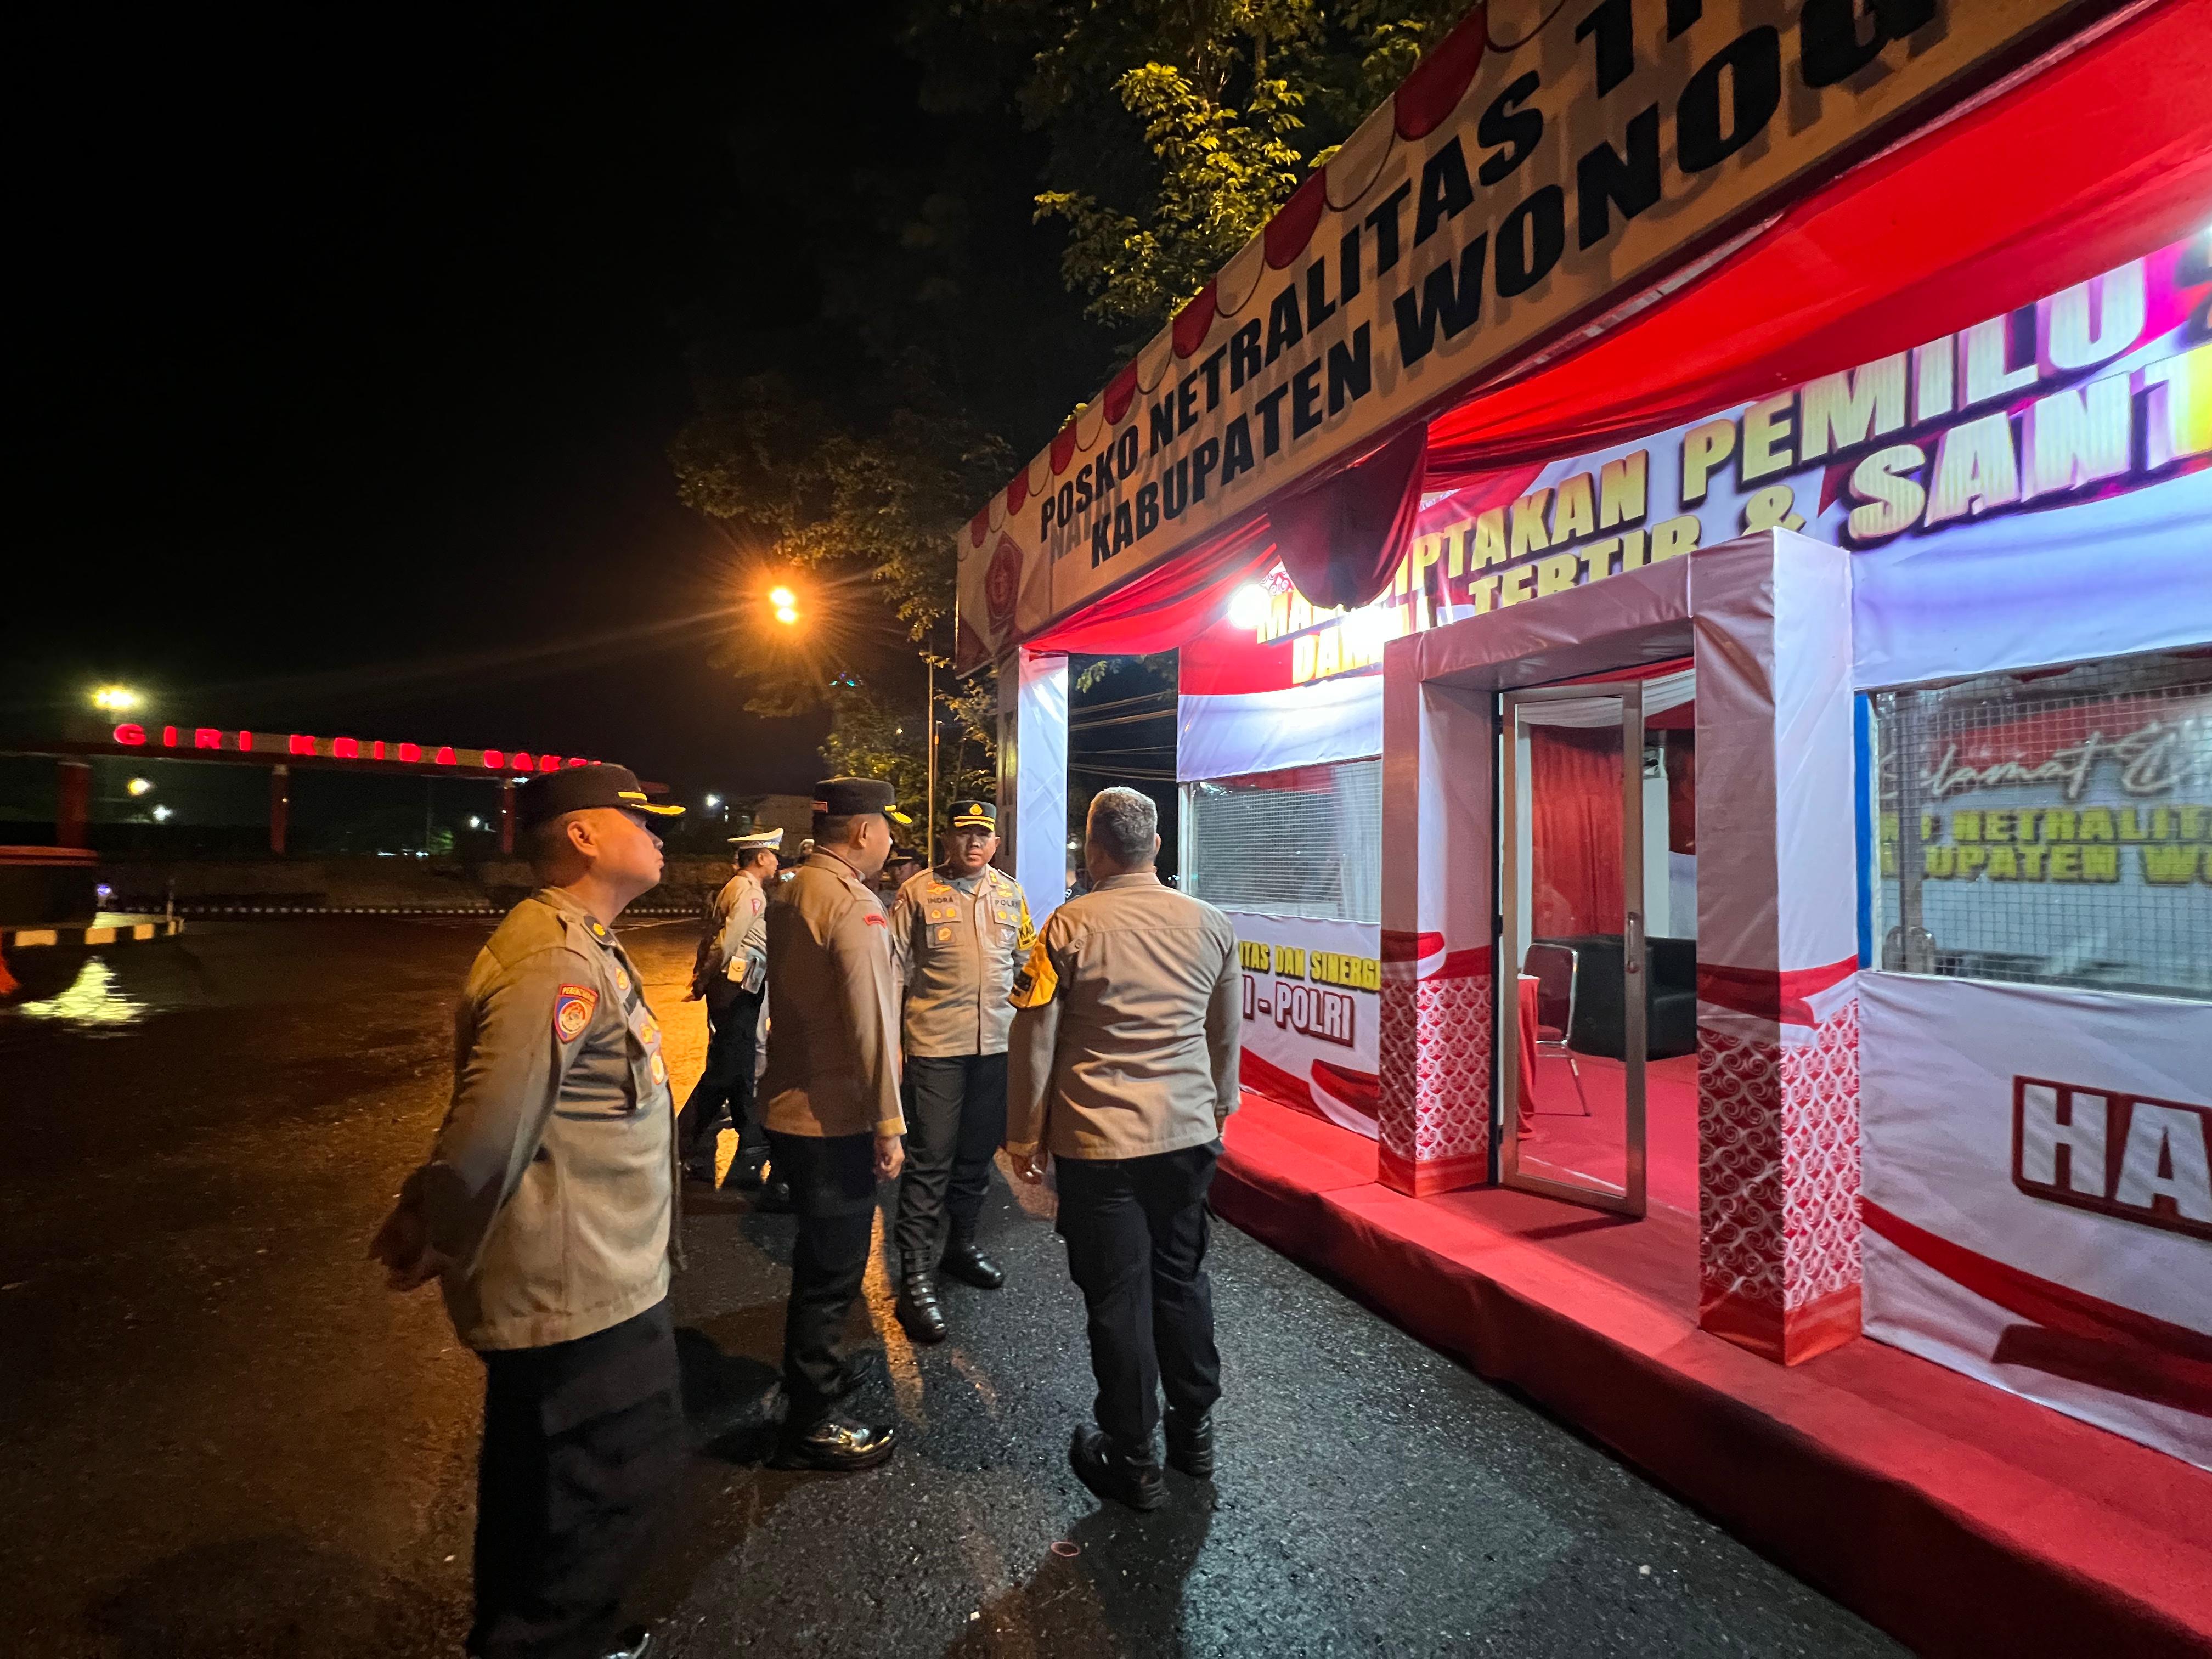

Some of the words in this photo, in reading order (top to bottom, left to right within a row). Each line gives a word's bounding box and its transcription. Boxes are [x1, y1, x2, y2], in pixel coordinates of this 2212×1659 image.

[1040, 424, 1139, 544] POSKO
[1150, 70, 1543, 458] NETRALITAS
[1683, 257, 2144, 502] PEMILU
[1091, 320, 1373, 570] KABUPATEN
[114, 723, 253, 752] GIRI
[289, 734, 457, 765] KRIDA
[1949, 803, 2212, 843] NETRALIT
[1274, 945, 1305, 980] DAN
[1275, 981, 1355, 1048] POLRI
